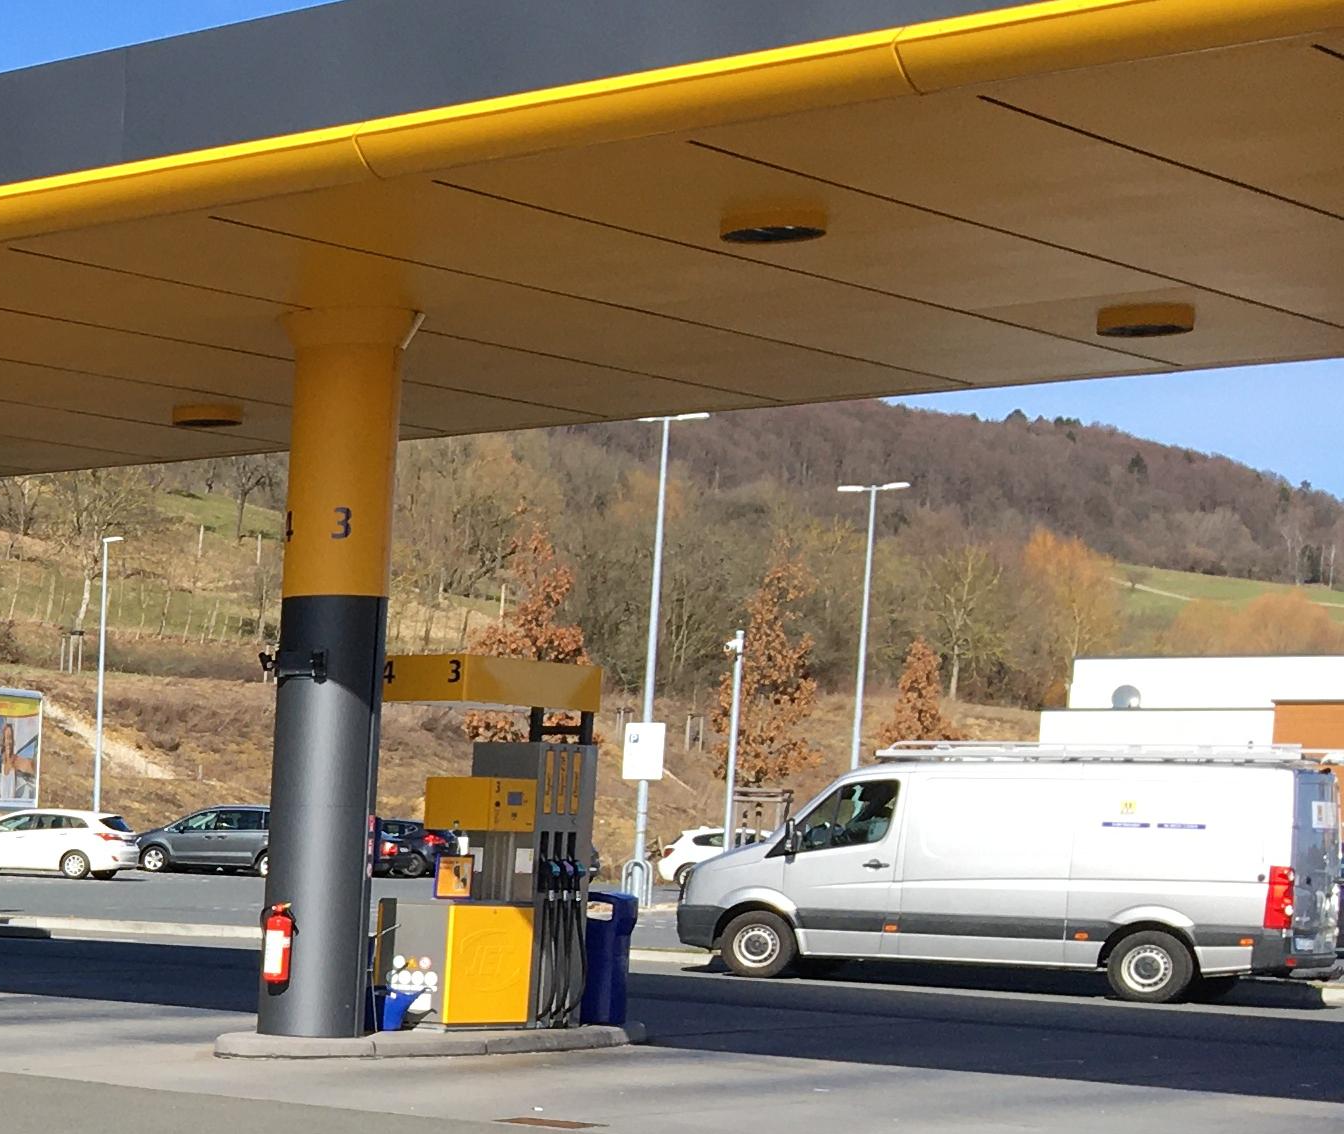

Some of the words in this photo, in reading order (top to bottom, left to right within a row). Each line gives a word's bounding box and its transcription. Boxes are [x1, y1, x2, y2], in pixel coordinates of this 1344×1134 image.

[331, 506, 352, 539] 3
[383, 660, 396, 684] 4
[447, 659, 462, 684] 3
